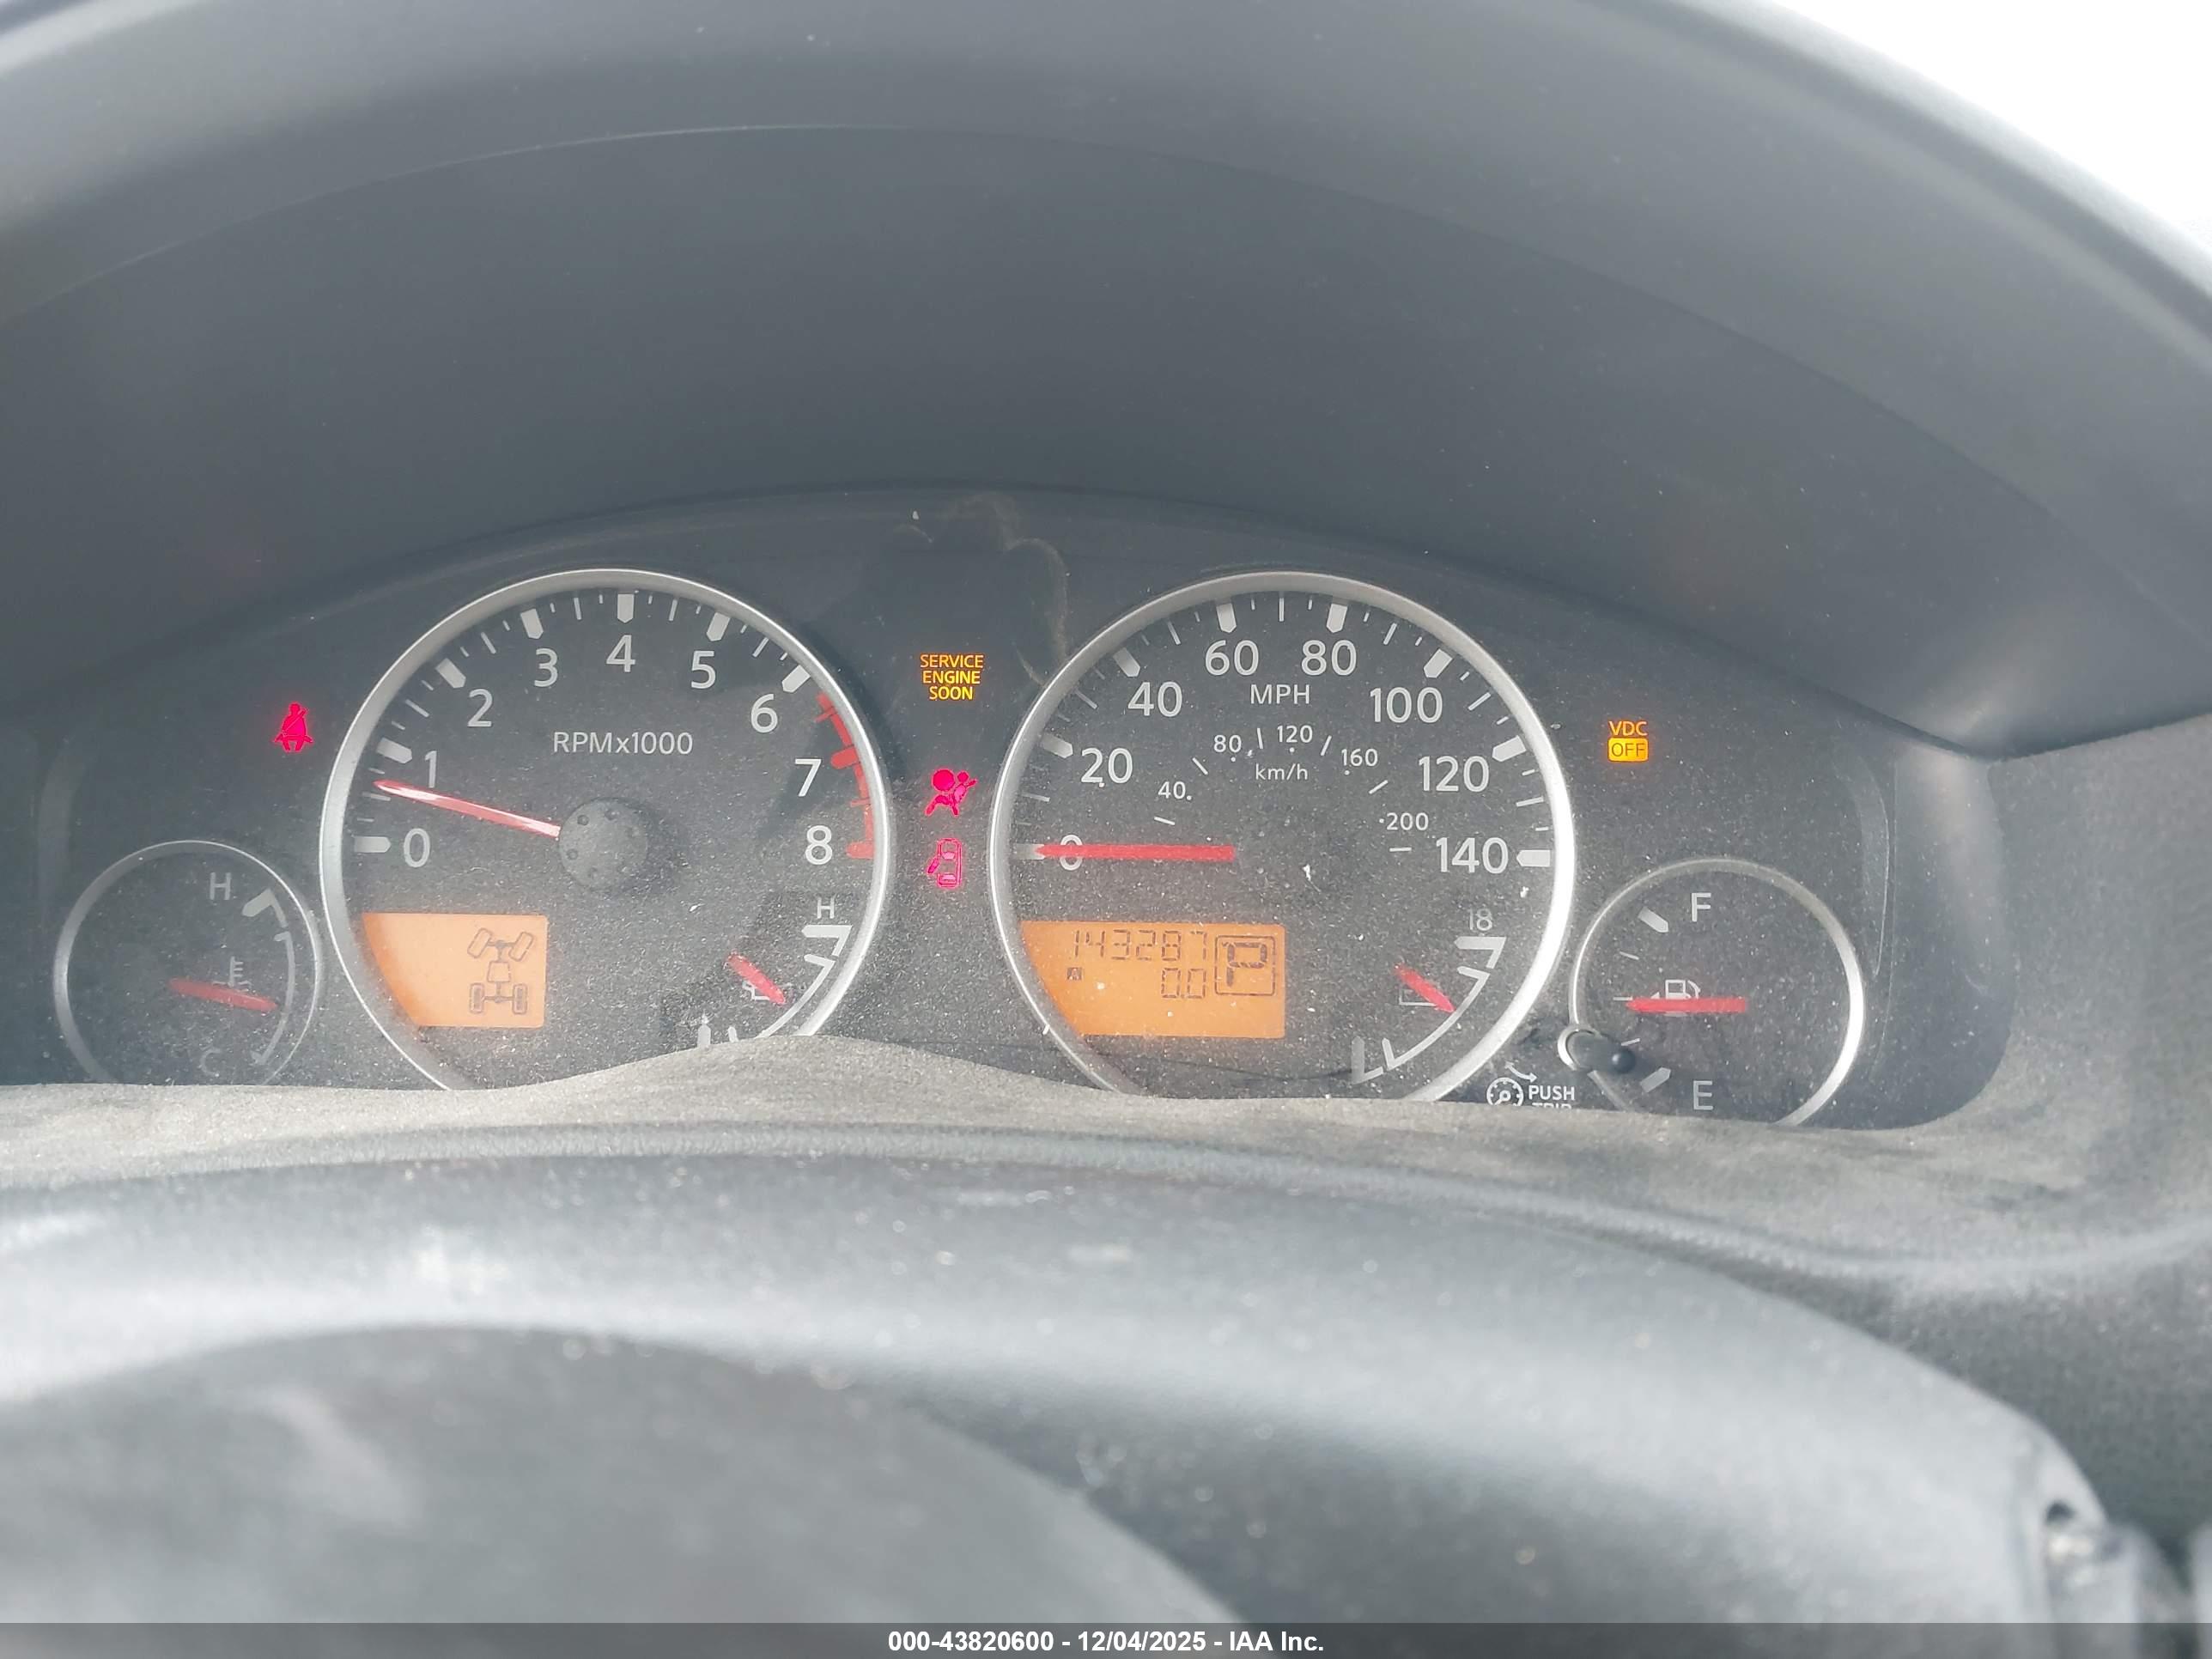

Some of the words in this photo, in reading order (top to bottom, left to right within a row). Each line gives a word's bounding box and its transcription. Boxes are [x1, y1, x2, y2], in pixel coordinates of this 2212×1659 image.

[534, 648, 559, 687] 3
[605, 635, 636, 672] 4
[920, 653, 984, 668] SERVICE
[1204, 640, 1260, 676] 60
[1300, 640, 1357, 676] 80
[691, 650, 717, 689] 5
[922, 670, 981, 684] ENGINE
[467, 688, 494, 727] 2
[929, 686, 973, 700] SOON
[1127, 681, 1183, 718] 40
[1249, 684, 1310, 705] MPH
[1370, 686, 1443, 723] 100
[750, 693, 778, 732] 6
[1608, 720, 1648, 736] VDC
[552, 731, 694, 755] RPMx1000
[1213, 734, 1242, 753] 80
[1276, 725, 1313, 744] 120
[1611, 742, 1645, 757] OFF
[425, 750, 437, 788] 1
[1080, 747, 1133, 785] 20
[1255, 763, 1309, 781] km/h
[1340, 748, 1378, 767] 160
[795, 758, 822, 797] 7
[1418, 756, 1490, 793] 120
[1158, 781, 1186, 800] 40
[1386, 812, 1429, 831] 200
[403, 827, 430, 868] 0
[805, 825, 833, 865] 8
[1059, 834, 1084, 872] 0
[1435, 836, 1509, 875] 140
[210, 872, 231, 900] H
[817, 896, 836, 919] H
[1468, 908, 1492, 931] 18
[1691, 893, 1711, 921] F
[1074, 929, 1207, 961] 143287
[1227, 943, 1268, 987] P
[1528, 1085, 1575, 1101] PUSH
[1692, 1080, 1714, 1111] E
